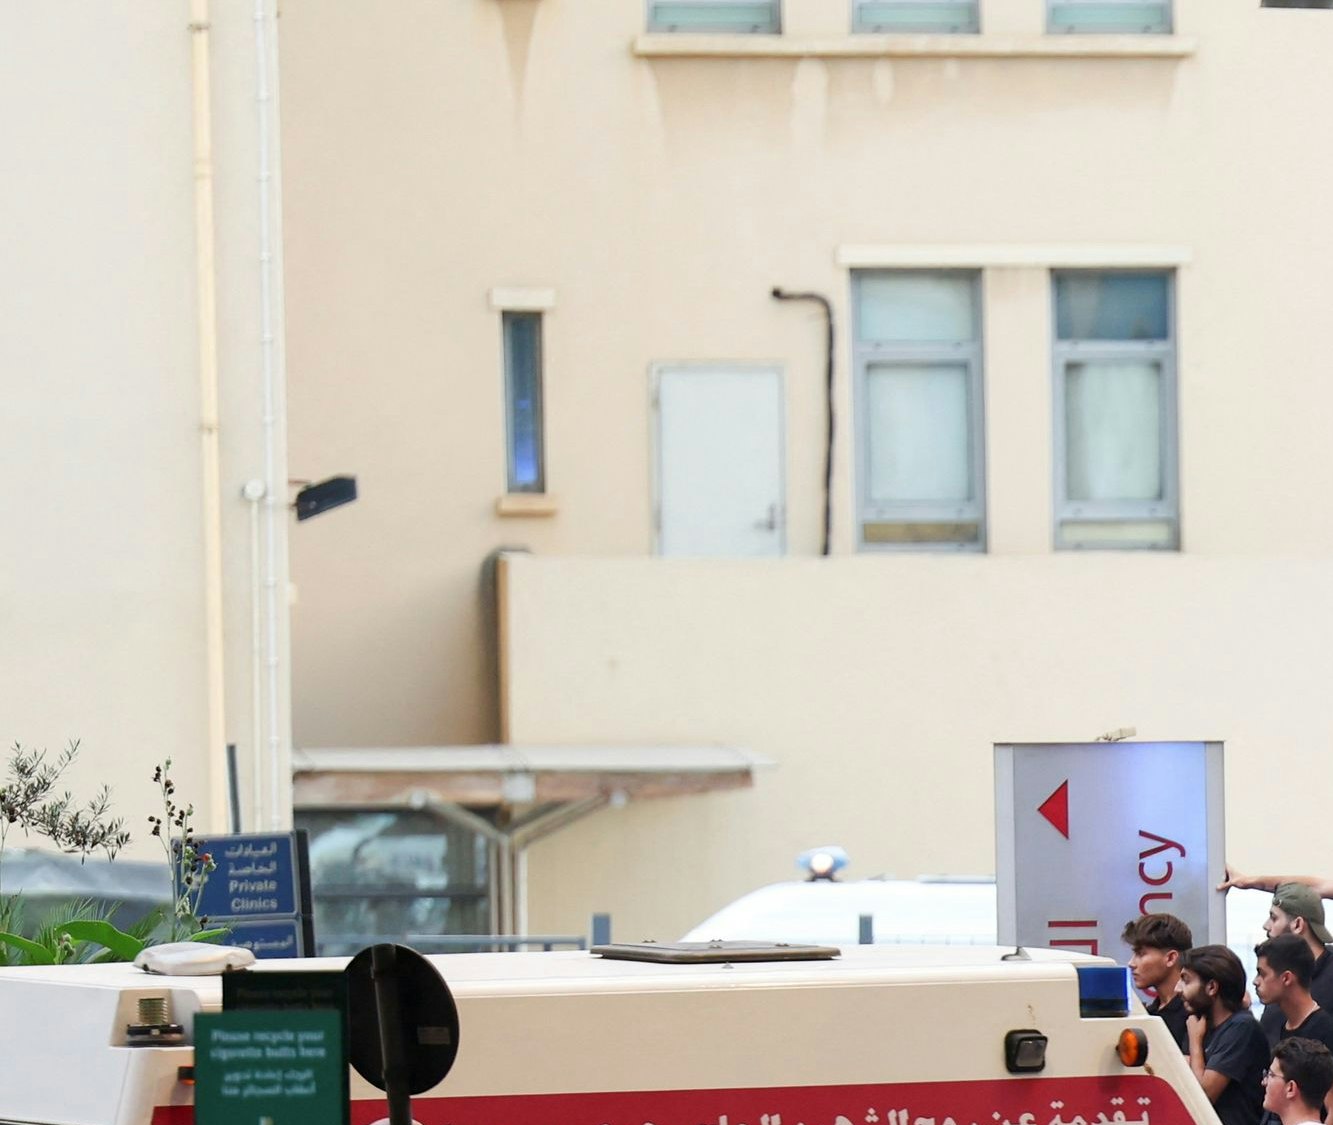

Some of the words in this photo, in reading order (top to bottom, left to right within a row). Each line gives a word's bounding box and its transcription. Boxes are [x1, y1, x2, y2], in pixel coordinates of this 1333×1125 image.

[229, 879, 278, 894] Private
[231, 897, 279, 912] Clinics
[210, 1028, 250, 1042] Please
[252, 1028, 294, 1045] recycle
